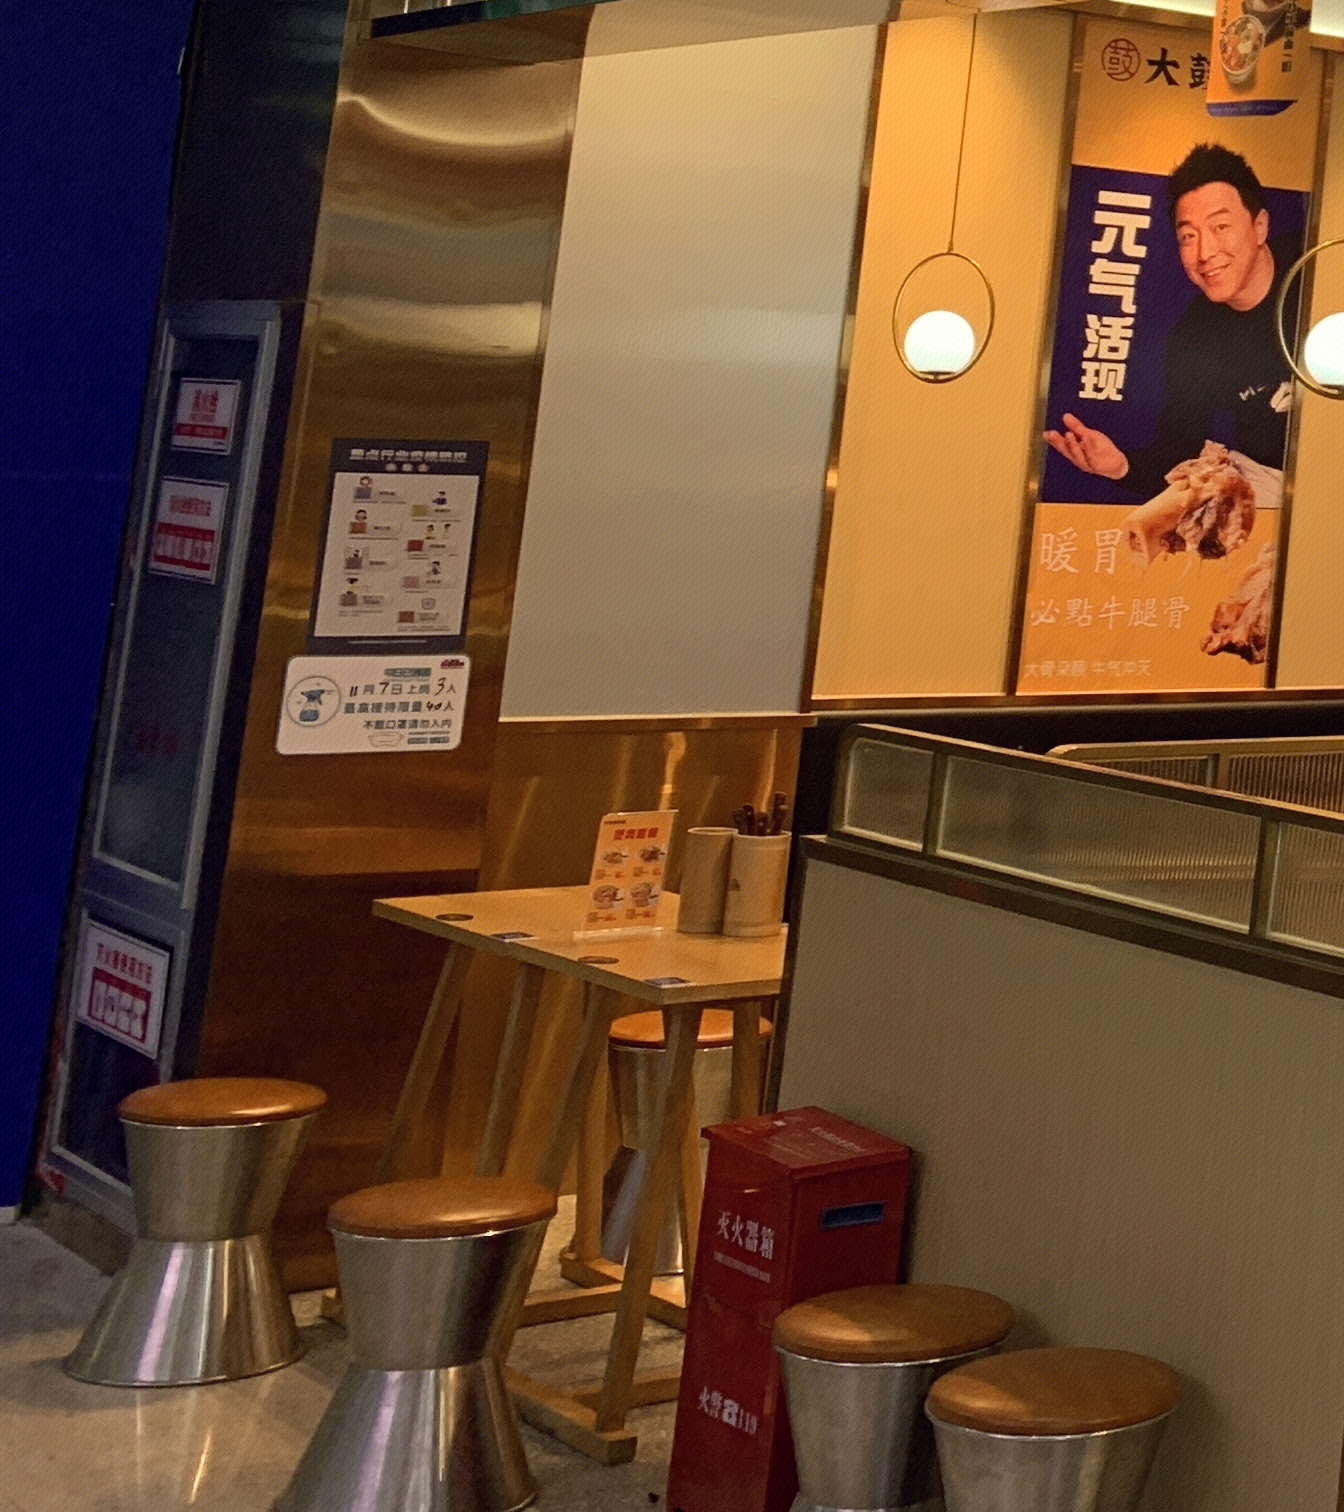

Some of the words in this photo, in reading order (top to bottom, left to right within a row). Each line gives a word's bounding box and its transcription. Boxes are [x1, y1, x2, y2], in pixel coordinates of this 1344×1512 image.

[1078, 189, 1152, 403] 元气活现
[1030, 594, 1191, 631] 必點牛腿骨
[716, 1209, 775, 1261] 灭火器箱
